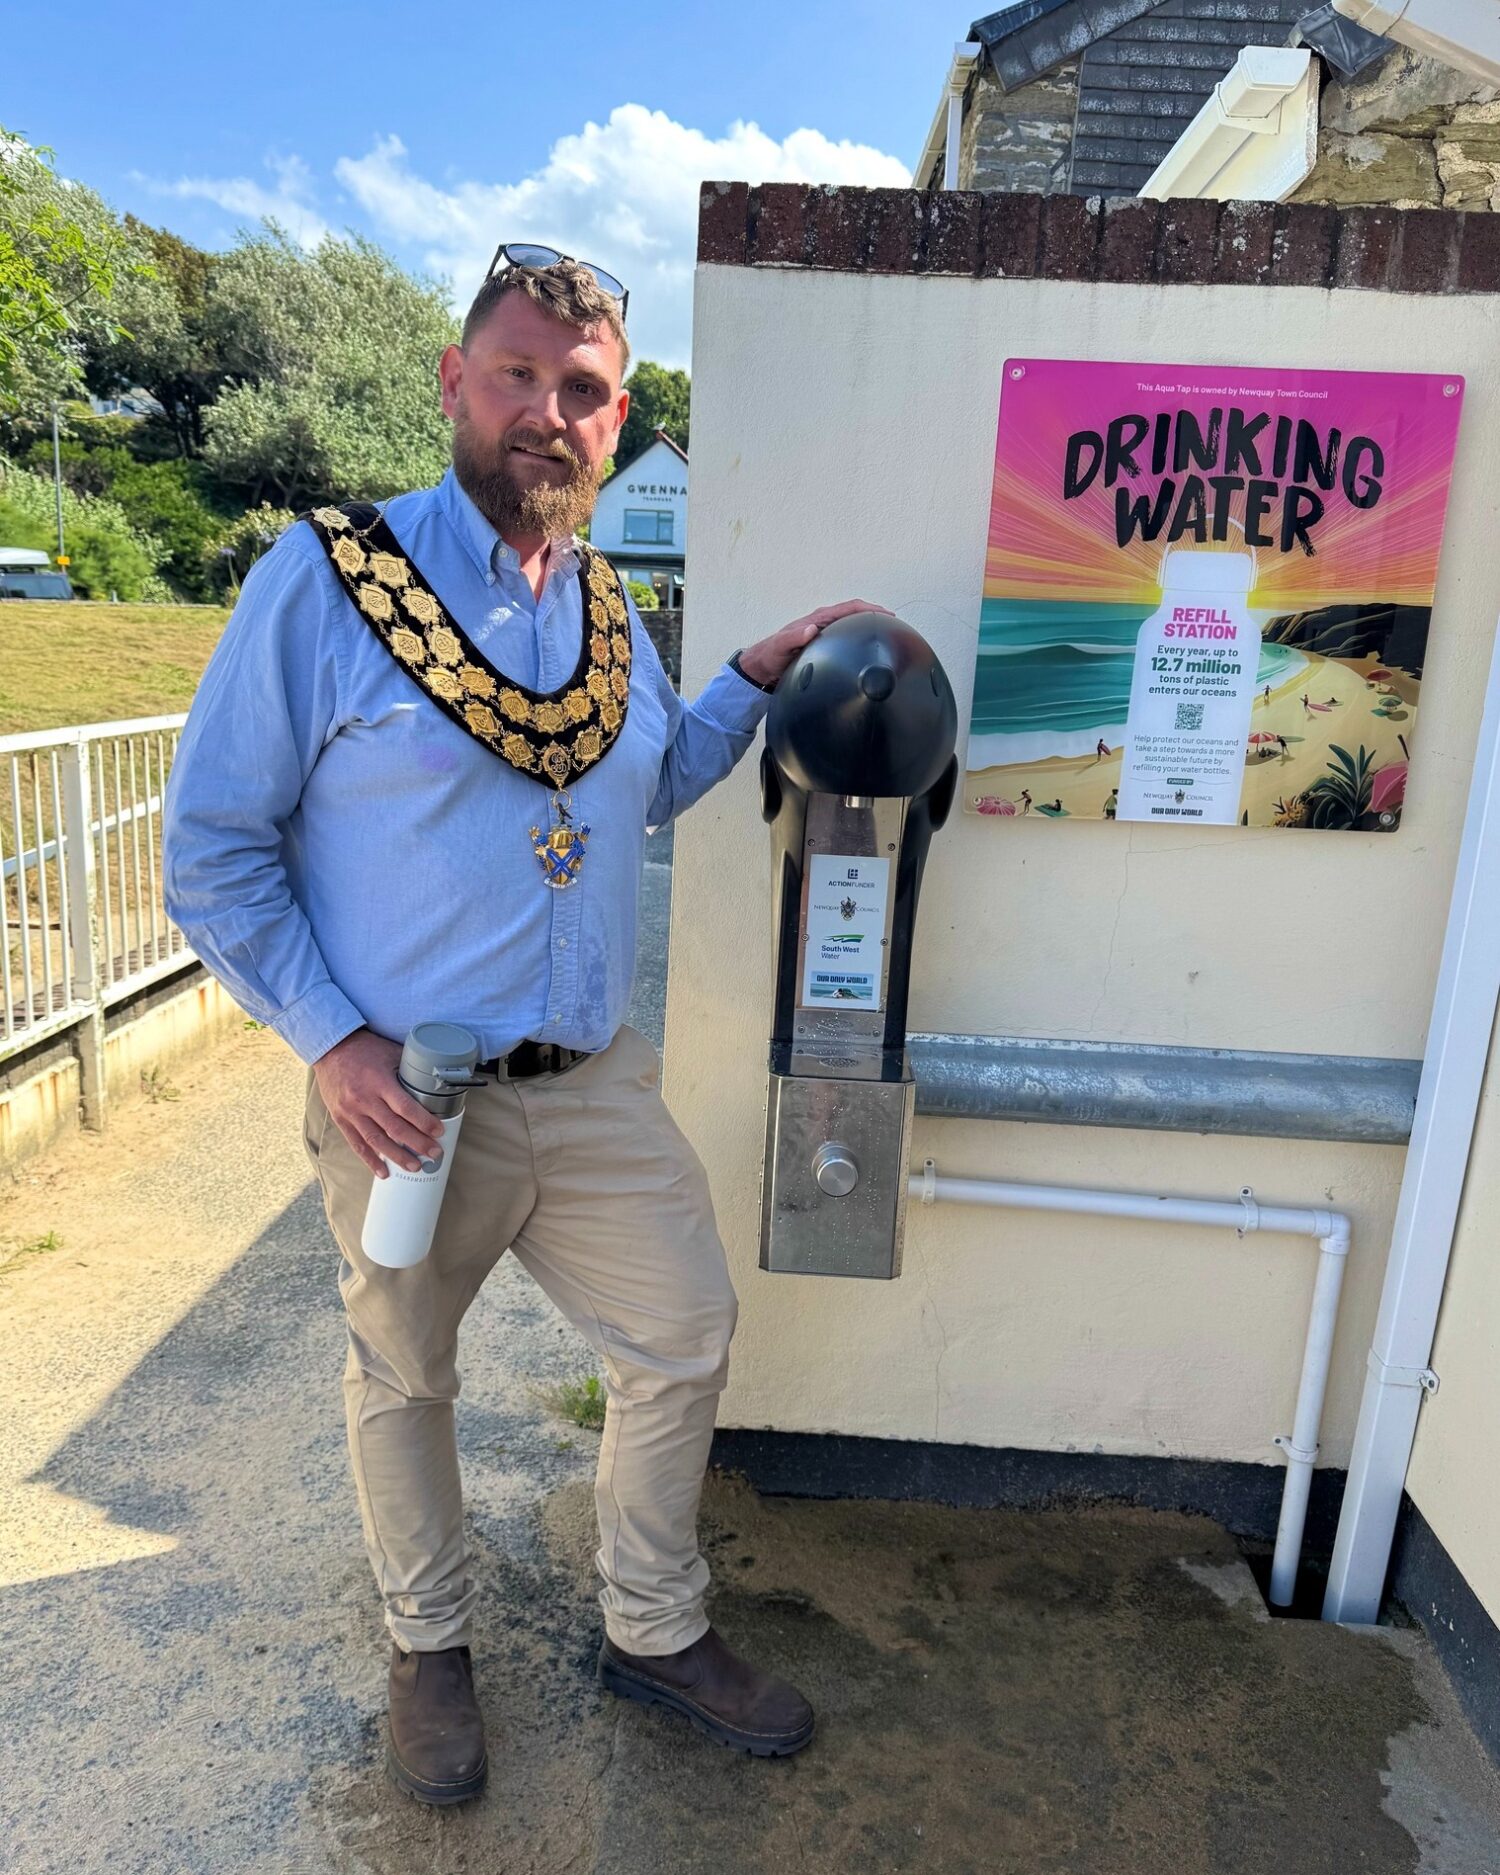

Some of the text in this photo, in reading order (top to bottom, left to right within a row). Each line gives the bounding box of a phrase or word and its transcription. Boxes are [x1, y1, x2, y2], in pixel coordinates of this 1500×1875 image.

[1136, 383, 1154, 391] This
[1154, 384, 1174, 393] Aqua
[1176, 385, 1191, 394] Tap
[1200, 386, 1226, 394] owned
[1228, 387, 1238, 396] by
[1239, 388, 1274, 398] Newquay
[1276, 389, 1297, 398] Town
[1299, 390, 1328, 399] Council
[1064, 408, 1384, 509] DRINKING
[628, 484, 687, 496] GWENNA
[1115, 474, 1324, 557] WATER
[1172, 608, 1232, 624] REFILL
[1164, 623, 1237, 640] STATION
[1158, 645, 1238, 658] Every year, up to
[1151, 657, 1241, 674] 12.7 million
[1160, 674, 1229, 686] tons of plastic
[1149, 686, 1180, 694] enters
[1201, 689, 1237, 697] oceans
[1134, 735, 1151, 744] Help
[1152, 736, 1180, 745] protect
[1159, 746, 1176, 754] step
[1144, 755, 1223, 766] sustainable future by
[1133, 764, 1161, 773] refilling
[1203, 767, 1232, 775] bottles.
[821, 944, 860, 954] South West
